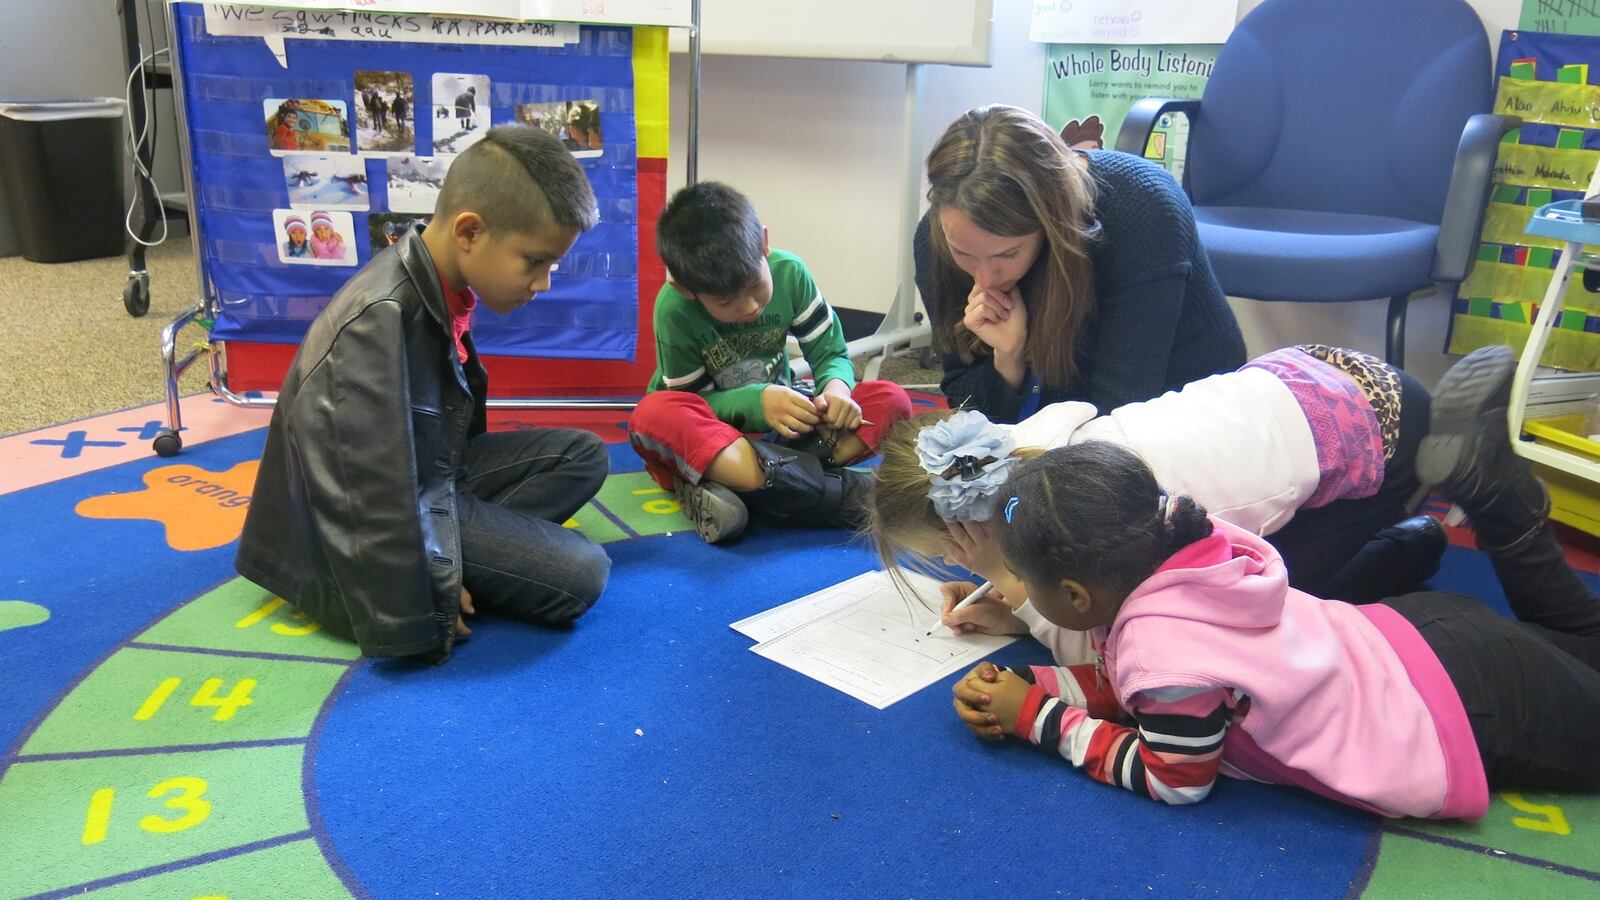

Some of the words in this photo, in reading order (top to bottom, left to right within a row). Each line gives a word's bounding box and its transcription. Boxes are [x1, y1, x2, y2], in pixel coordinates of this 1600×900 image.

[1052, 51, 1104, 79] Whole
[1110, 48, 1151, 77] Body
[1157, 49, 1214, 78] Listeni
[1089, 79, 1109, 89] Larry
[1134, 81, 1143, 89] to
[1144, 81, 1171, 90] remind
[1173, 83, 1188, 92] you
[1189, 83, 1198, 91] to
[1090, 90, 1110, 98] listen
[1112, 91, 1128, 99] with
[1504, 96, 1533, 112] Alan
[167, 475, 254, 508] orang
[133, 677, 258, 721] 14
[81, 776, 213, 845] 13
